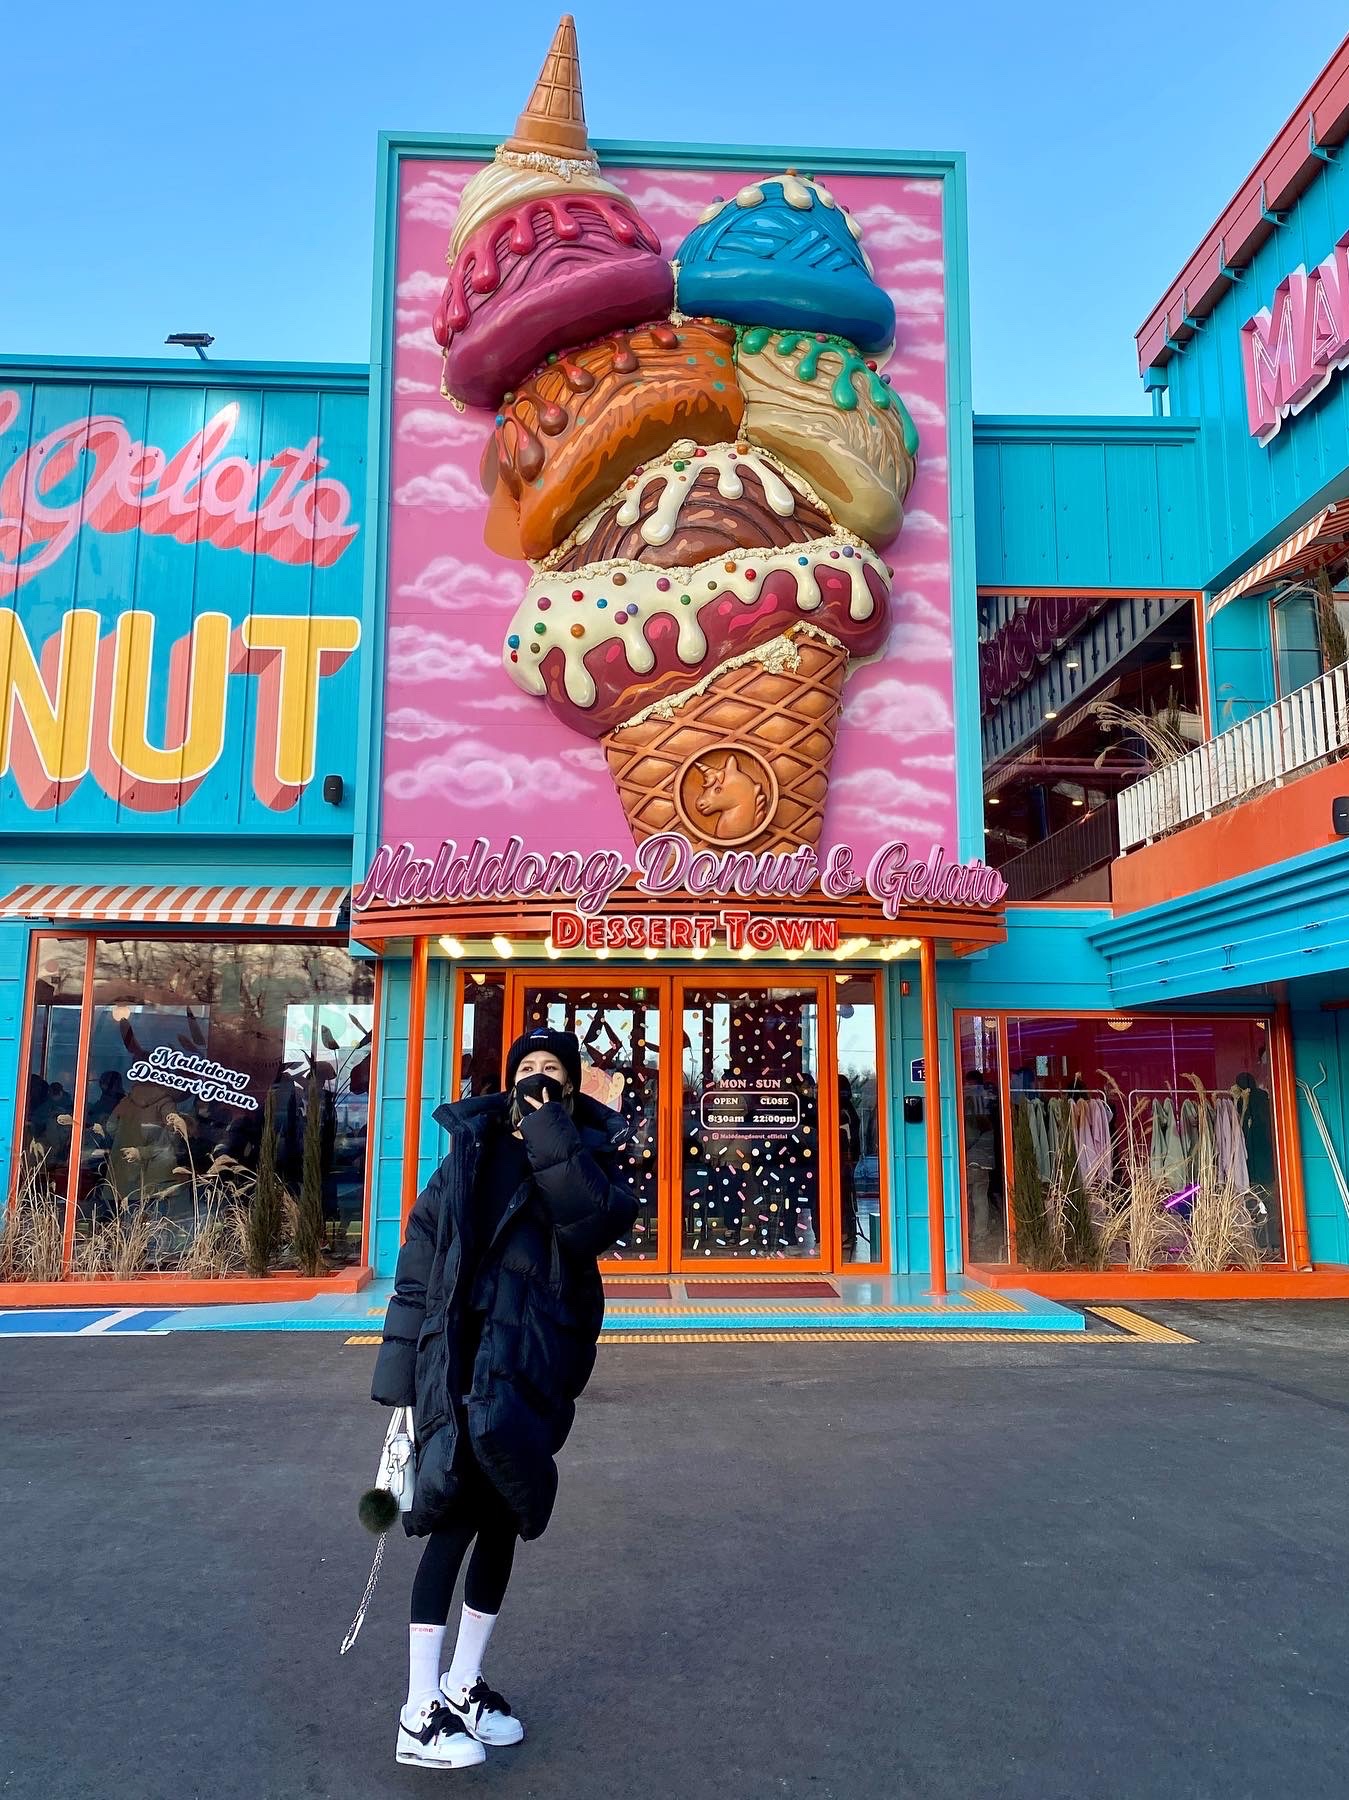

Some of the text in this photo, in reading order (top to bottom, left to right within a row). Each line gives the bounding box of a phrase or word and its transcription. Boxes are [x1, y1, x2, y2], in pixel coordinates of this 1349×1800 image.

[1240, 229, 1349, 442] MA
[0, 401, 361, 578] Gelato
[352, 832, 1008, 920] Malddong Donut & Gelato
[551, 910, 841, 951] DESSERT TOWN
[127, 1061, 259, 1111] Dessert Town
[149, 1046, 250, 1090] Malddong
[720, 1079, 747, 1089] MON
[755, 1079, 781, 1089] SUN
[707, 1114, 797, 1125] 8:30am 22:00pm
[713, 1097, 790, 1105] OPEN CLOSE
